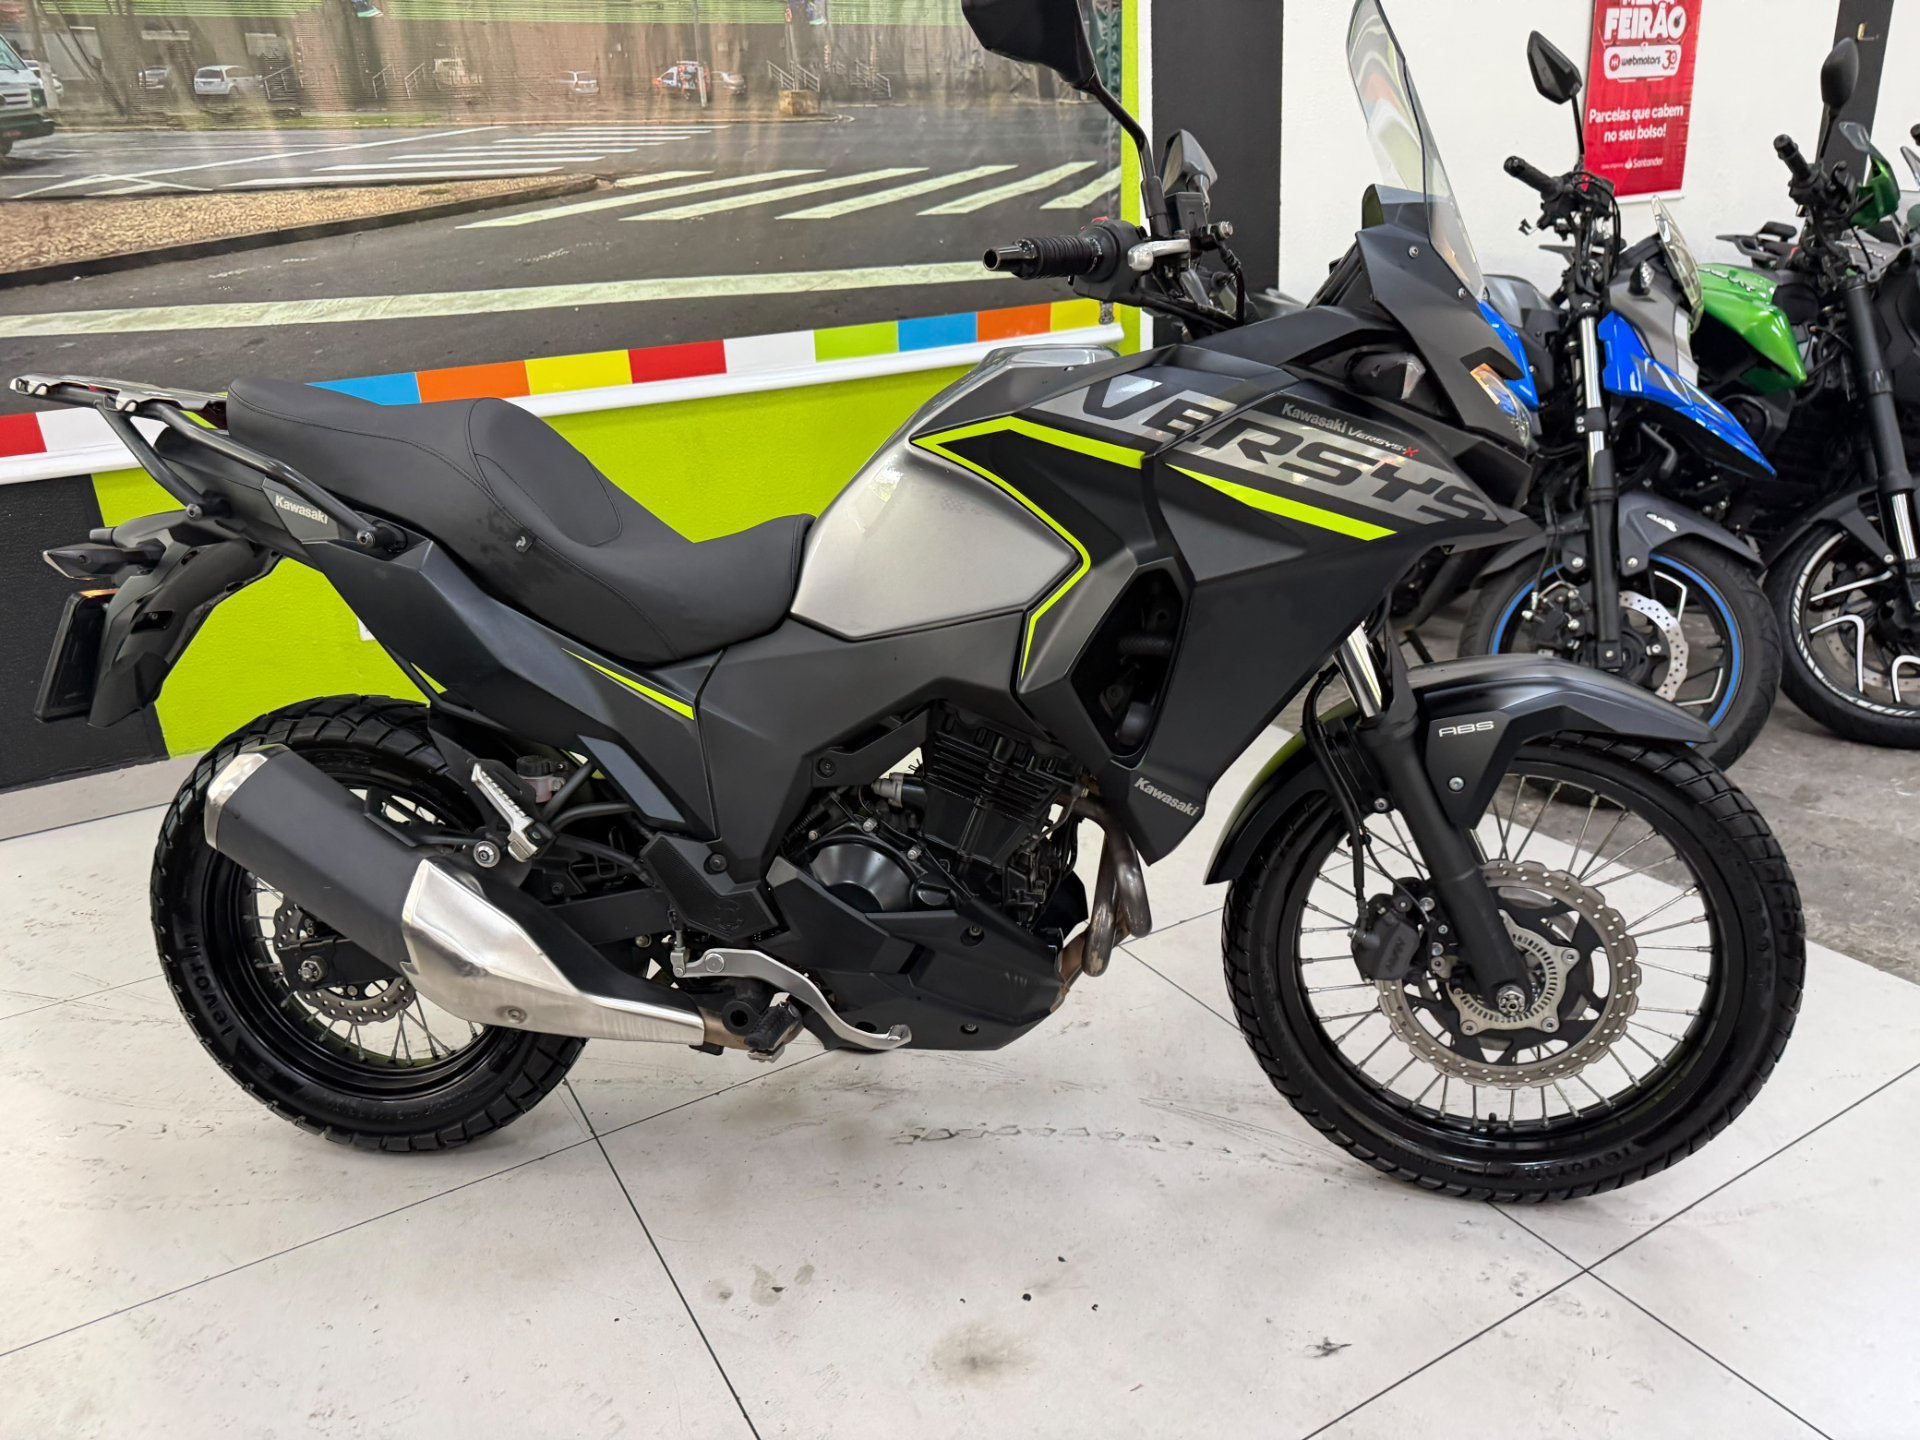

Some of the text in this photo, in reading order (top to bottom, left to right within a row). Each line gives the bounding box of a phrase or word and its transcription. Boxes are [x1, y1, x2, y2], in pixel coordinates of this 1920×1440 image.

[1604, 4, 1686, 40] FEIRÃO
[1622, 55, 1661, 66] webmotors
[1589, 104, 1684, 123] Parcelas que cabem
[1604, 124, 1667, 142] no seu bolso!
[1632, 157, 1664, 168] Santander
[1282, 402, 1348, 433] Kawasaki
[1082, 376, 1498, 524] VERSYS
[275, 494, 329, 525] Kawasaki
[1439, 720, 1494, 737] ABS
[1134, 777, 1200, 817] Kawasaki
